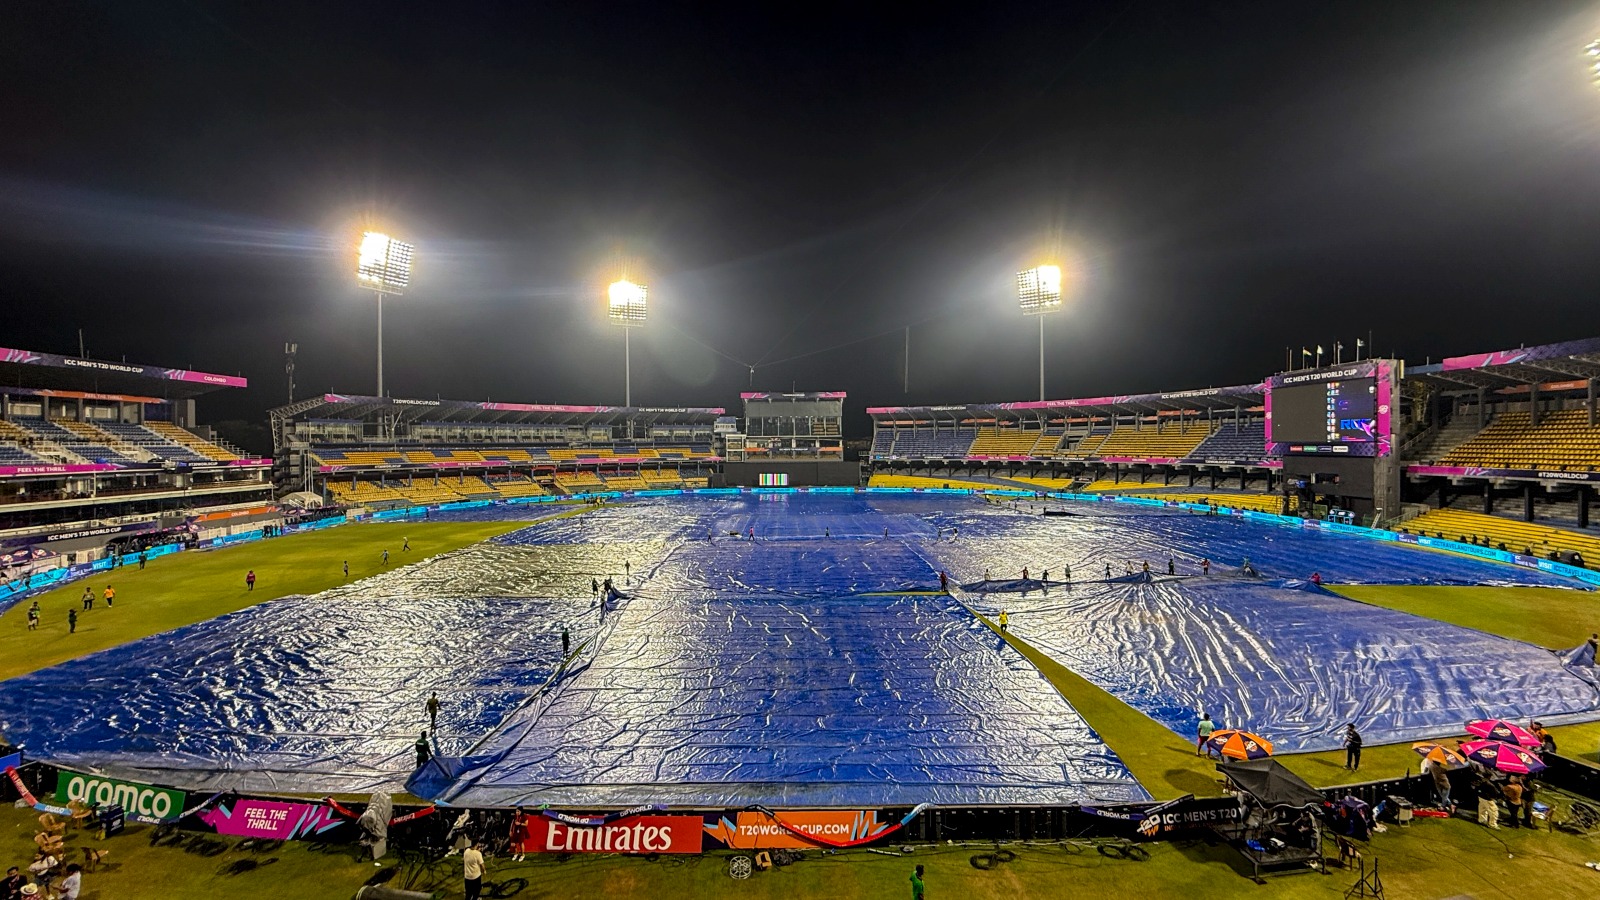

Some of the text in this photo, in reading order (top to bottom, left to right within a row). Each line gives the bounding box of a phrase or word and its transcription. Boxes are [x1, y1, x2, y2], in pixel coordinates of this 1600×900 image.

[77, 360, 97, 368] MEN'S
[110, 364, 132, 372] WORLD
[1432, 540, 1496, 558] ICCTRAVELANDTOURS.COM
[92, 562, 106, 570] VISIT
[1538, 562, 1552, 570] VISIT
[67, 776, 172, 818] aramco
[244, 808, 288, 820] FEEL THE
[629, 804, 652, 814] WORLD
[1096, 809, 1120, 818] WORLD
[558, 814, 580, 823] WORLD
[1162, 814, 1181, 824] ICC
[1184, 810, 1216, 822] MEN'S
[1218, 808, 1237, 819] T20
[246, 818, 278, 830] THRILL
[546, 820, 672, 851] Emirates
